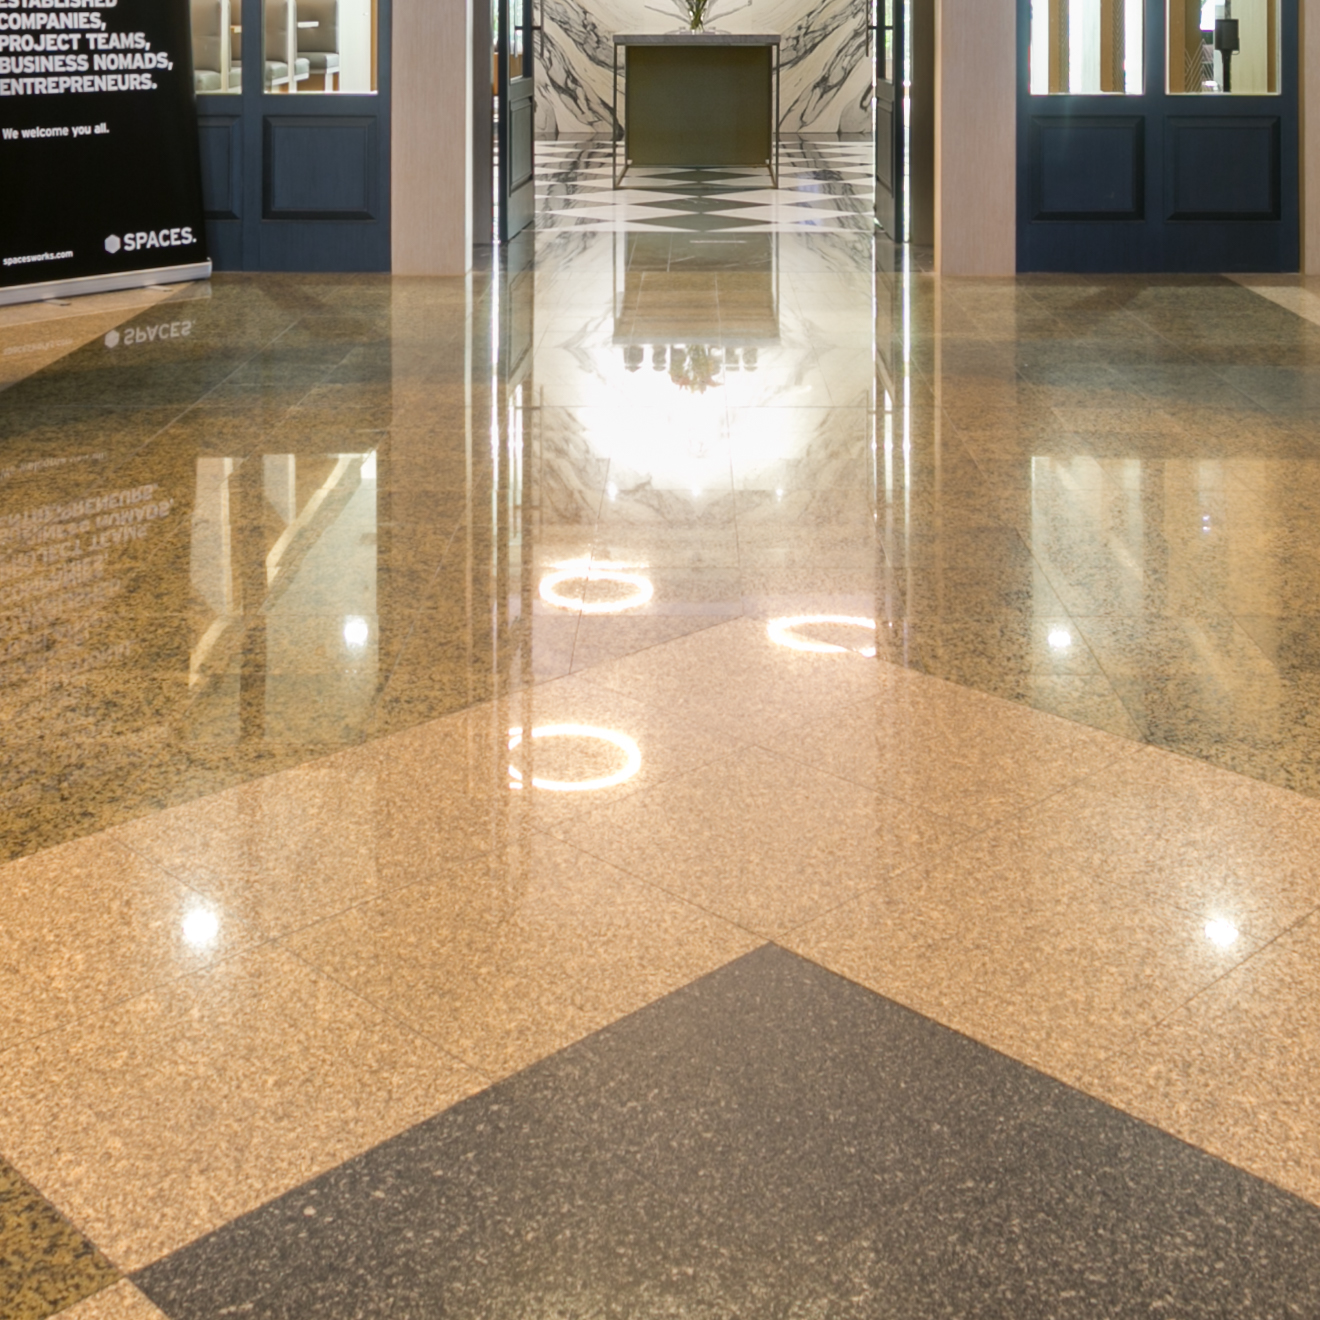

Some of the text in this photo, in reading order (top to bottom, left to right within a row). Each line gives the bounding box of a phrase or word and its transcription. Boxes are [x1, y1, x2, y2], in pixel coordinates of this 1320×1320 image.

[85, 32, 151, 51] TEAMS,
[93, 52, 174, 71] NOMADS,
[2, 122, 110, 140] We welcome you all.
[123, 227, 197, 252] SPACES.
[2, 250, 74, 267] spacesworks.com
